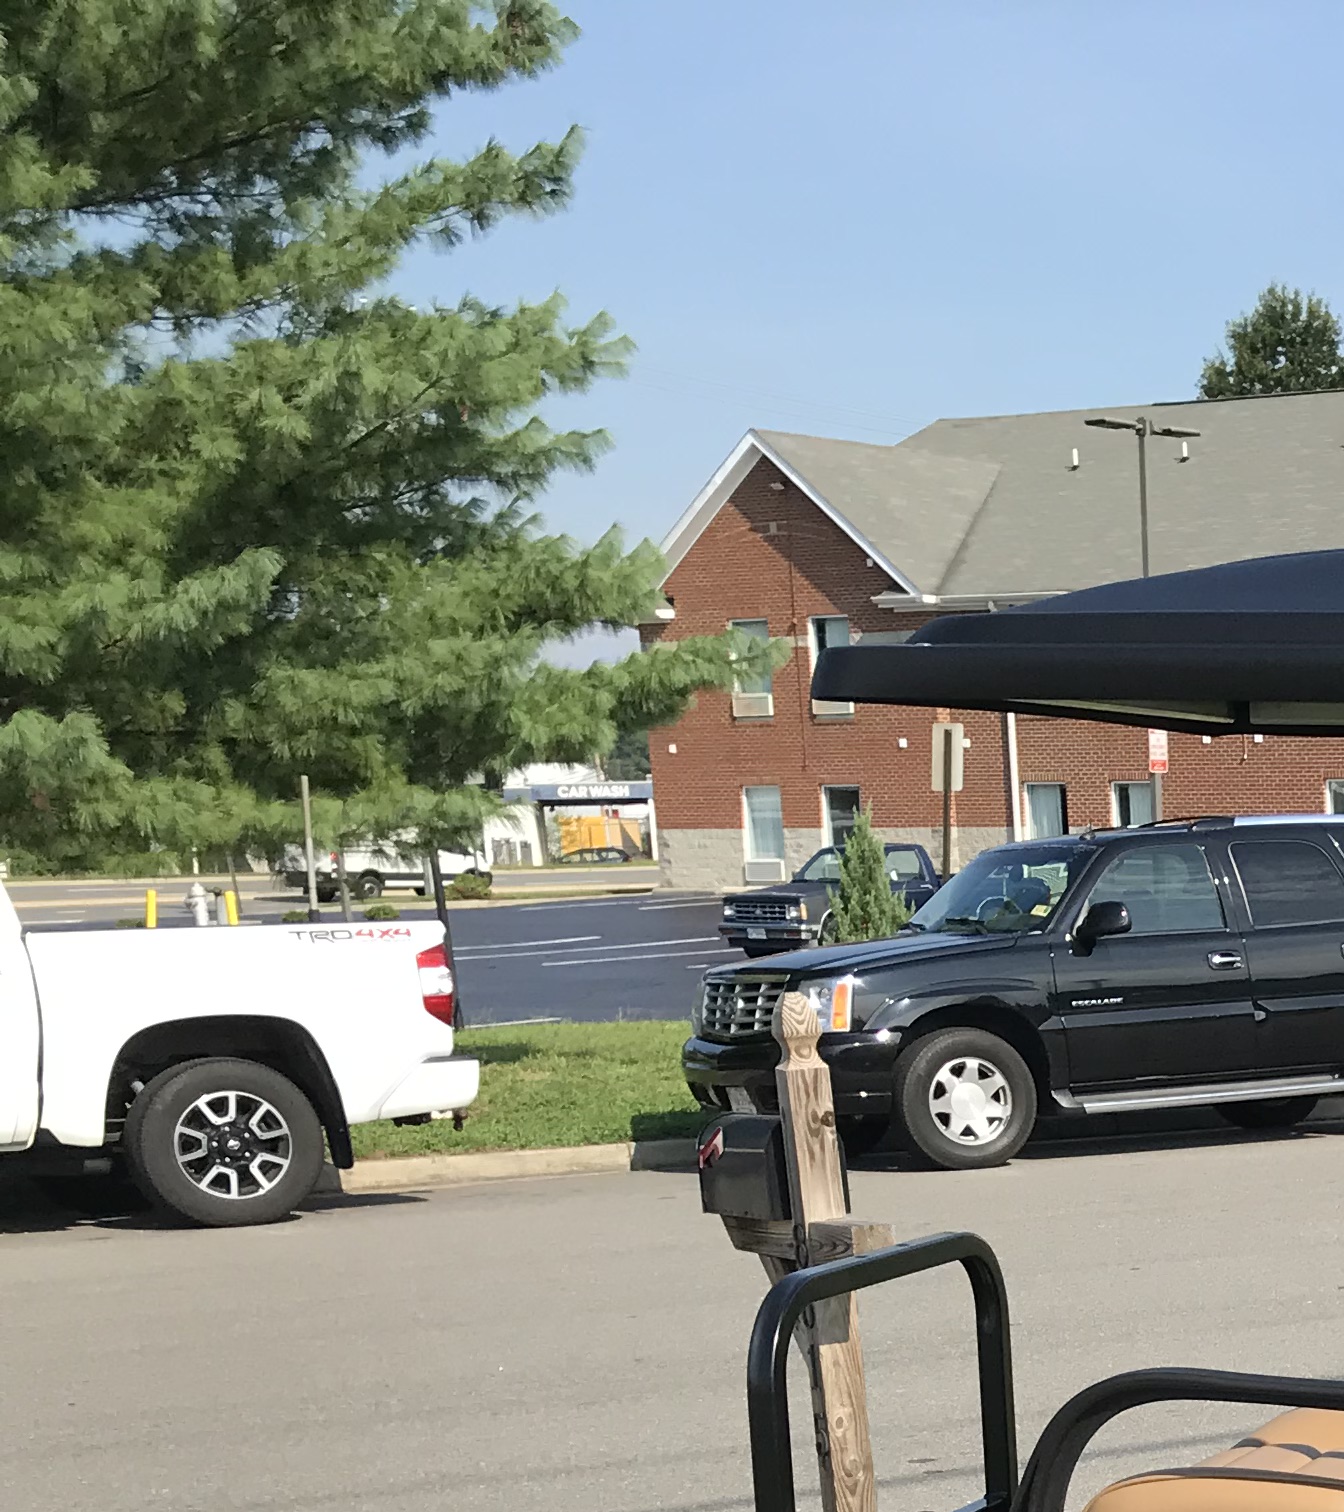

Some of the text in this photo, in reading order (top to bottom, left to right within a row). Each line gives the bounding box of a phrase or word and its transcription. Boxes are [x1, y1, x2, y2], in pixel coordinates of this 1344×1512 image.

[557, 784, 630, 798] CAR WASH
[288, 929, 353, 944] TRD
